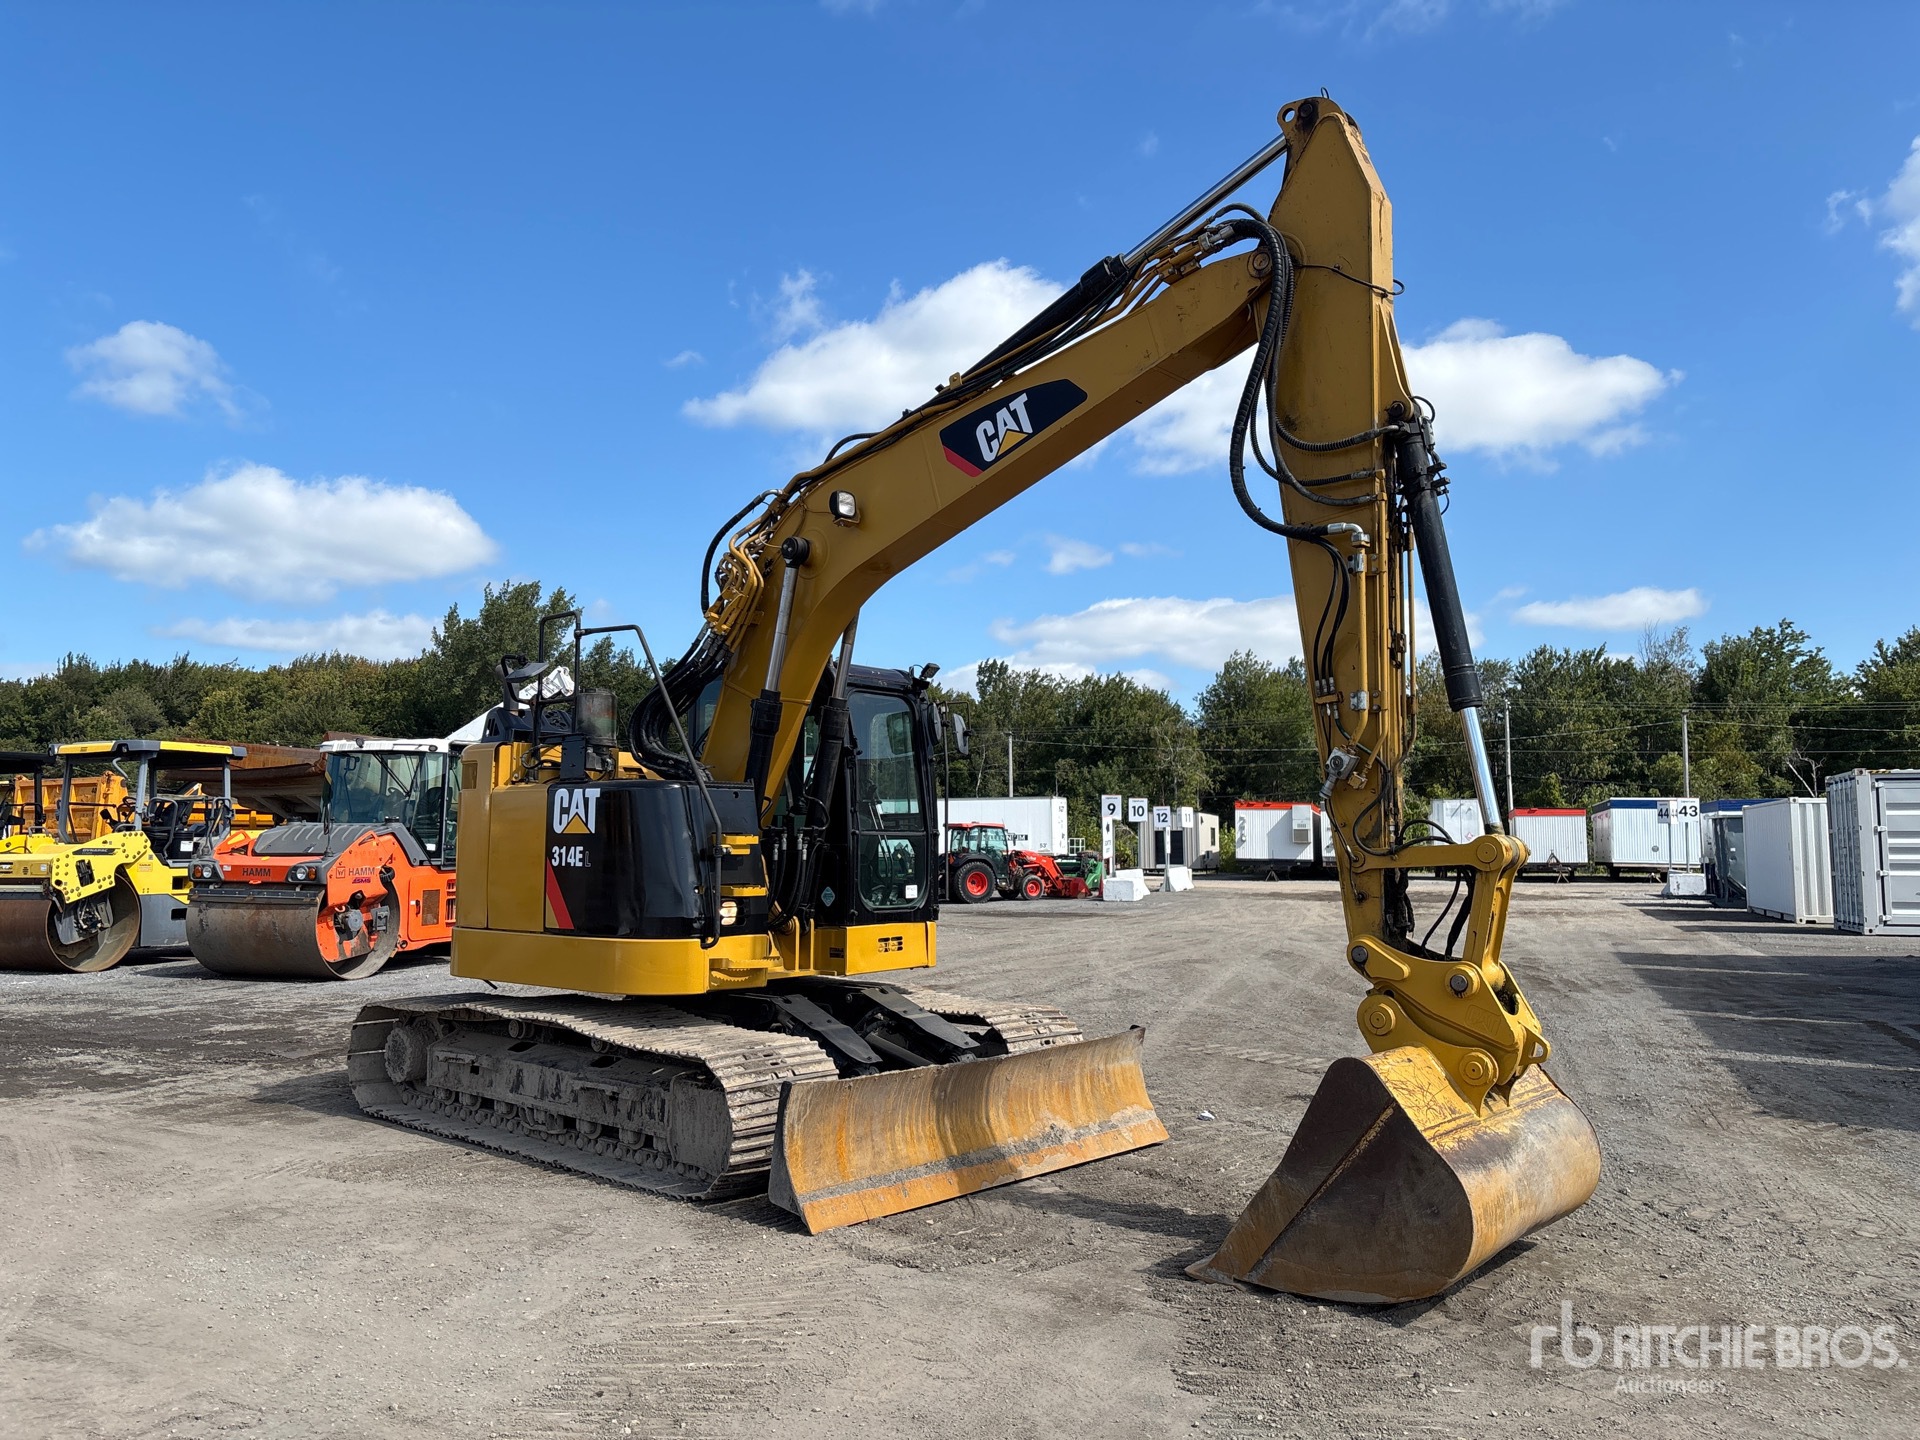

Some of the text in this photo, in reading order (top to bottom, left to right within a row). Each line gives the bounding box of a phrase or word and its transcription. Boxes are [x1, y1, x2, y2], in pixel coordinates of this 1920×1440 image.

[976, 392, 1033, 462] CAT
[553, 788, 600, 833] CAT
[1107, 803, 1116, 815] 9
[1132, 806, 1145, 817] 10
[1658, 808, 1669, 818] 44
[1679, 805, 1698, 817] 43
[1157, 813, 1168, 823] 12
[1184, 813, 1191, 822] 11
[242, 868, 271, 877] HAMM
[348, 867, 375, 876] HAMM
